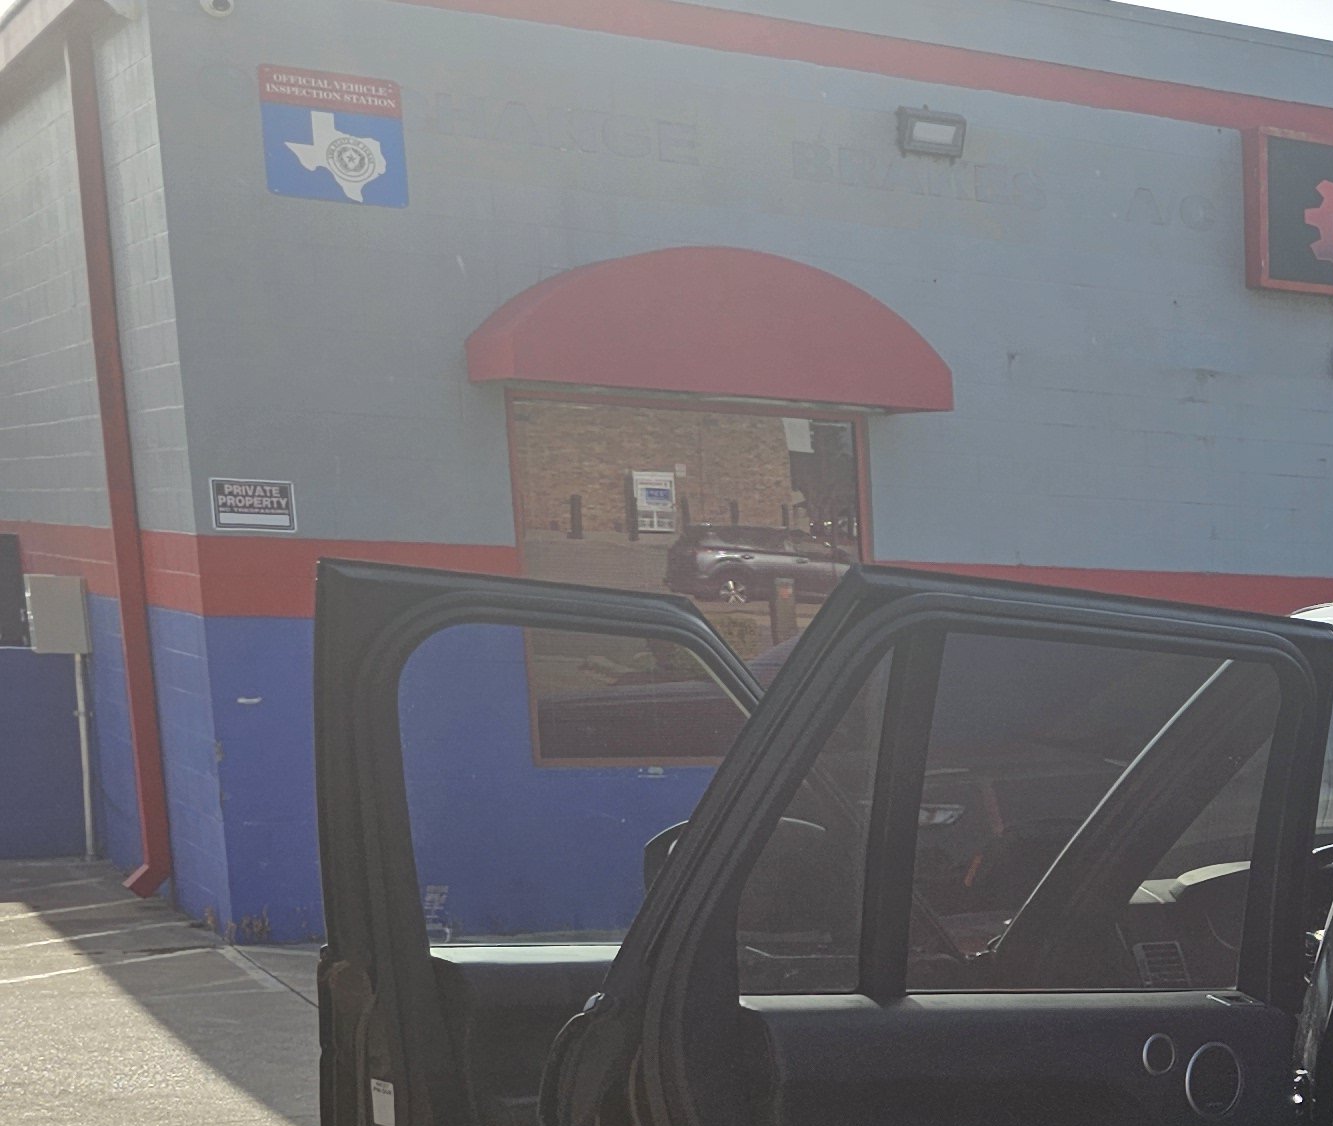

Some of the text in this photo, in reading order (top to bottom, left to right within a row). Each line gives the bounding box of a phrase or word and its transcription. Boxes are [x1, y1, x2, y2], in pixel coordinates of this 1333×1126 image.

[273, 73, 388, 96] OFFICIAL VEHICLE
[266, 83, 396, 108] INSPECTION STATION
[224, 484, 280, 497] PRIVATE
[217, 495, 288, 509] PROPERTY
